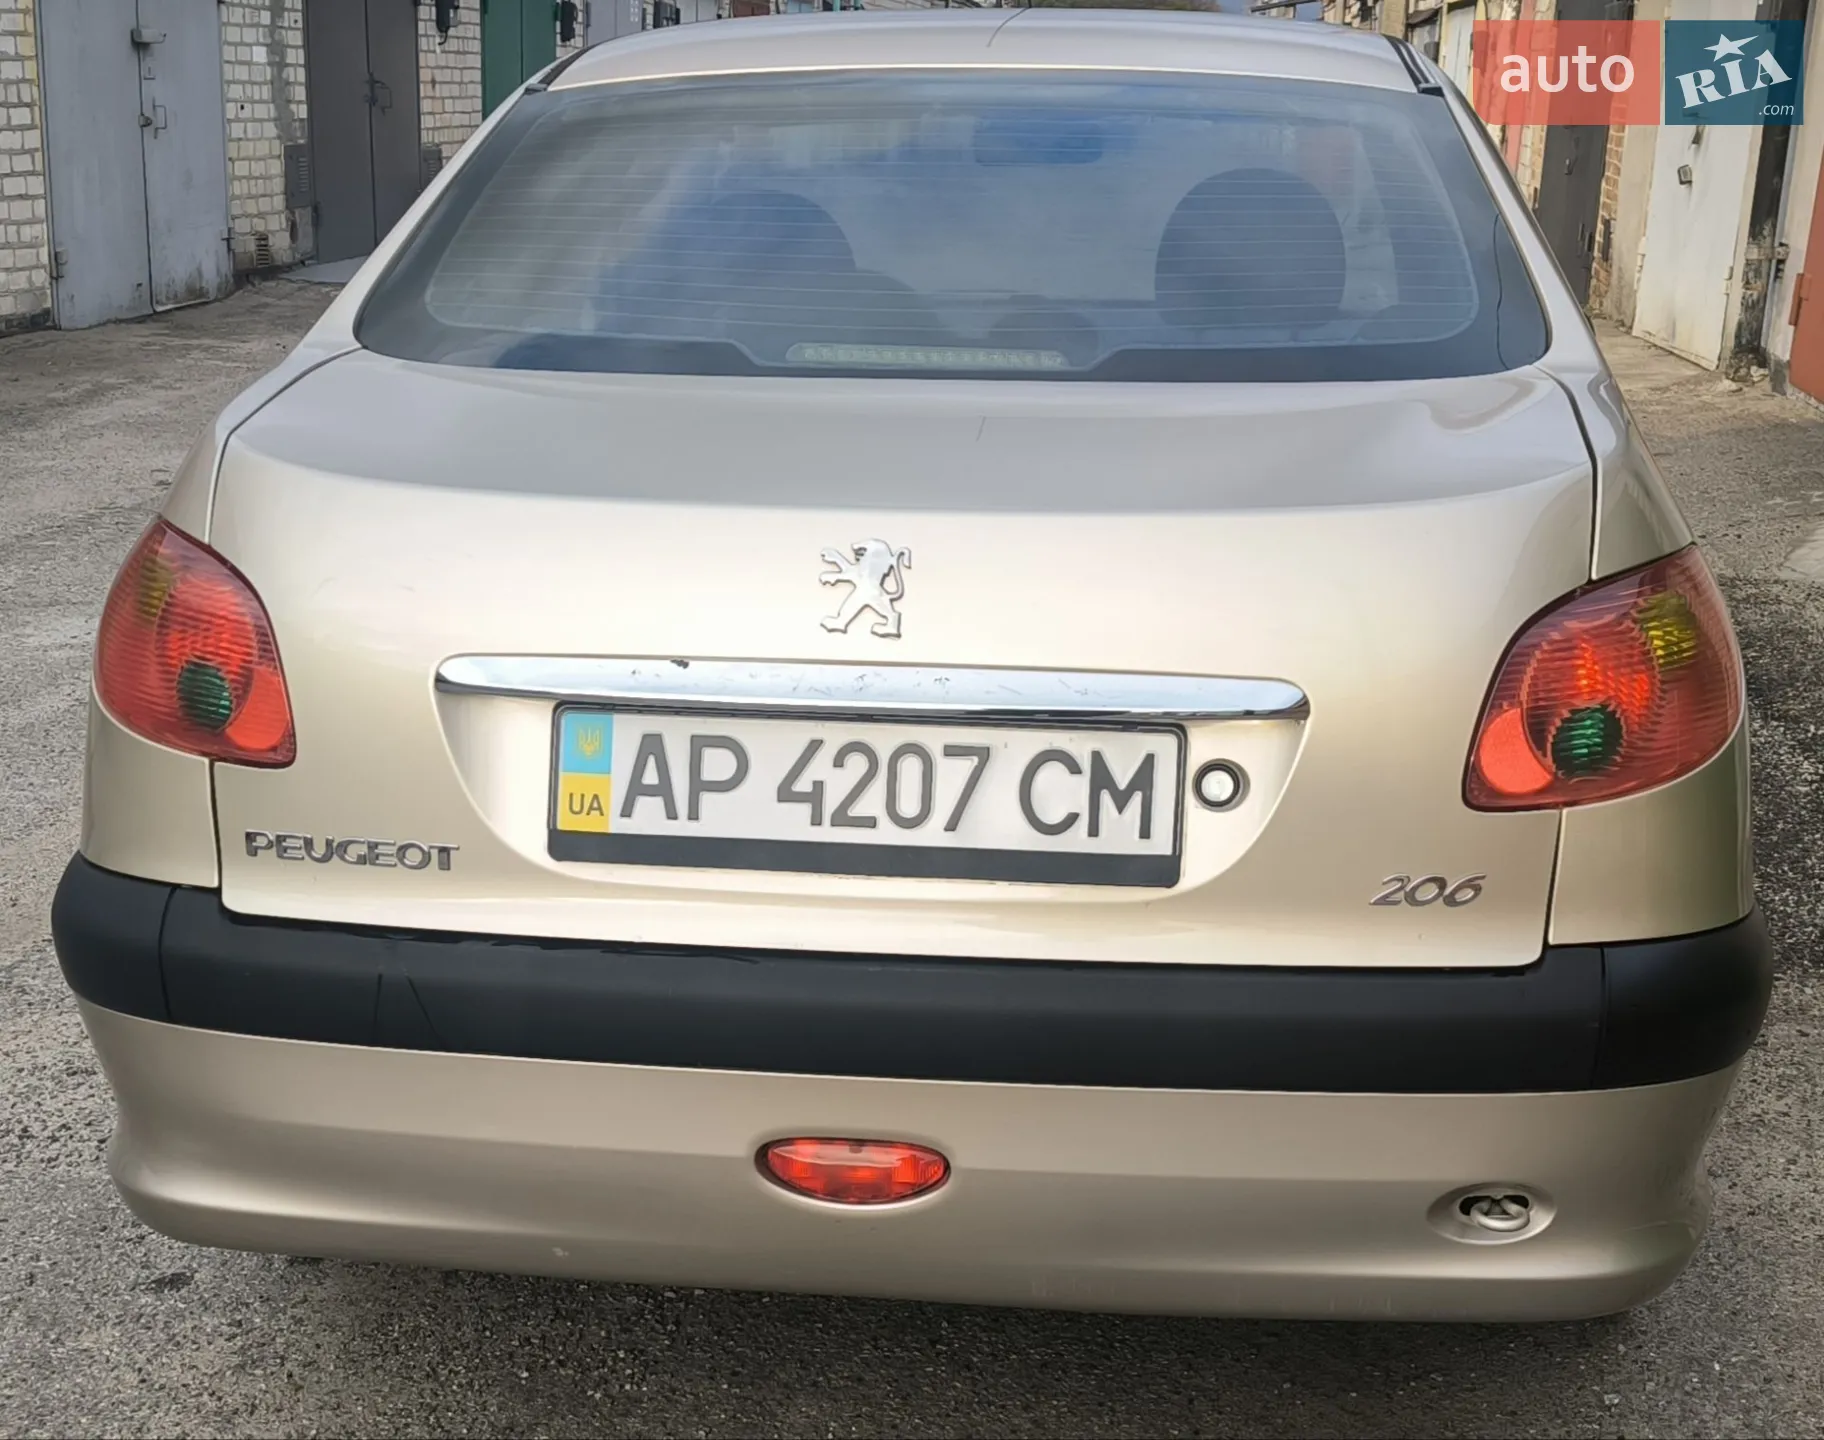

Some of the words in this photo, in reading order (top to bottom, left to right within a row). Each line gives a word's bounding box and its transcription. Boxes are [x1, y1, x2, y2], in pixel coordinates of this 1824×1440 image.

[568, 793, 604, 817] UA
[620, 733, 749, 821] AP
[776, 738, 990, 832] 4207
[1019, 749, 1155, 840] CM
[245, 829, 460, 870] PEUGEOT
[1369, 873, 1487, 907] 206
